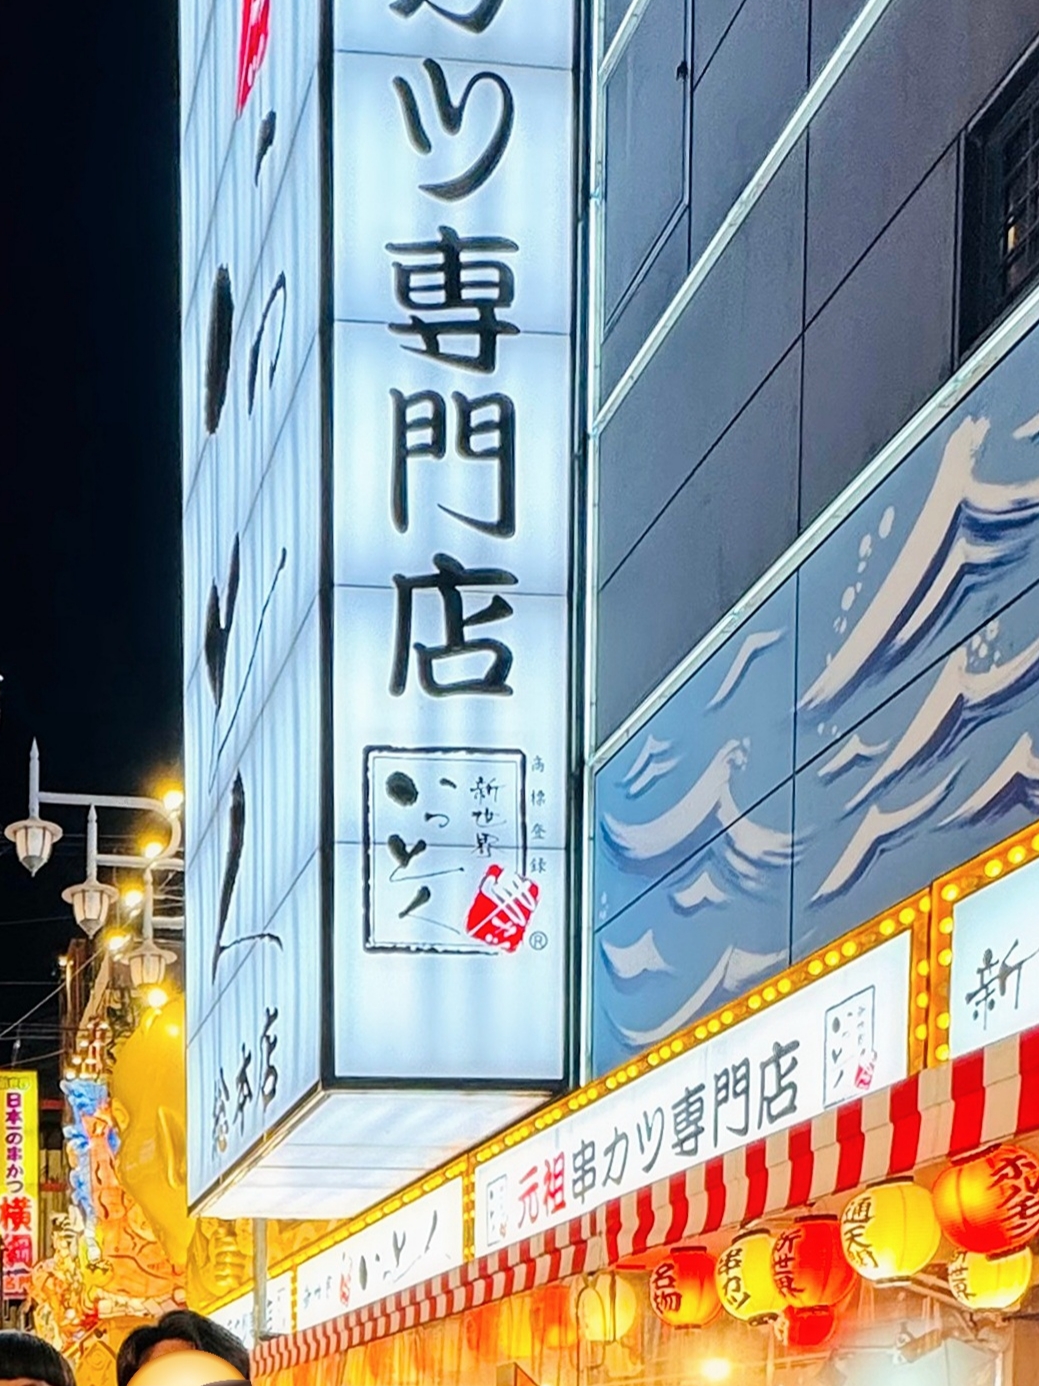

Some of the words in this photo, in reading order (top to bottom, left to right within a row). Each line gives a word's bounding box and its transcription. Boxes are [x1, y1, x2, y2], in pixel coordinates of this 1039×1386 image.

[384, 0, 521, 698] ツ専門店
[4, 1092, 24, 1194] 日本一の串かつ
[652, 1262, 682, 1315] 名物
